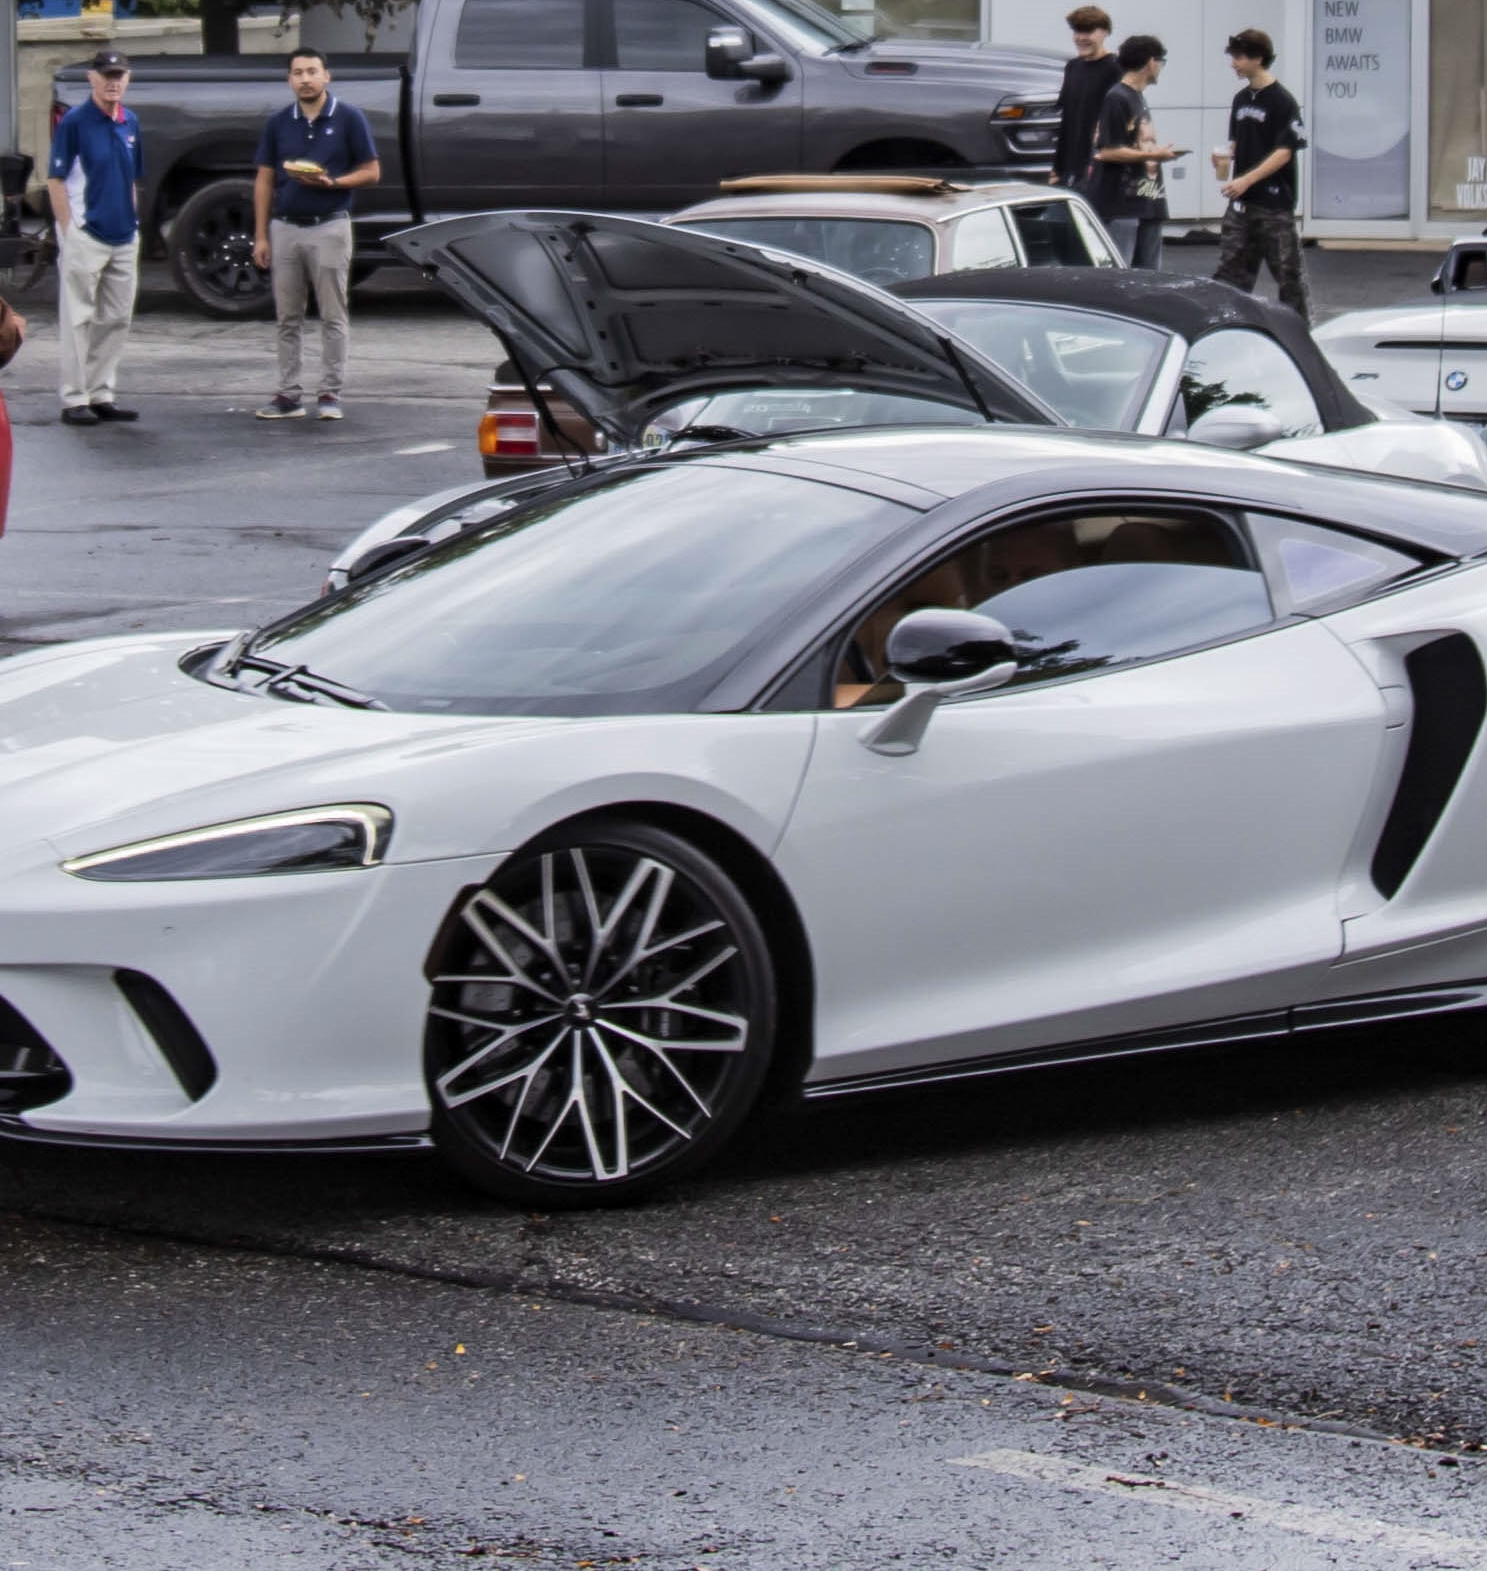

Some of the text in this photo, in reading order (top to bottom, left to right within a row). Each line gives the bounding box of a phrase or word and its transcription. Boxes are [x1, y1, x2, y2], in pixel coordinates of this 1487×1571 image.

[1324, 1, 1360, 17] NEW
[1325, 27, 1363, 44] BMW
[1325, 54, 1380, 71] AWAITS
[1325, 81, 1358, 98] YOU
[1467, 156, 1486, 182] JAY
